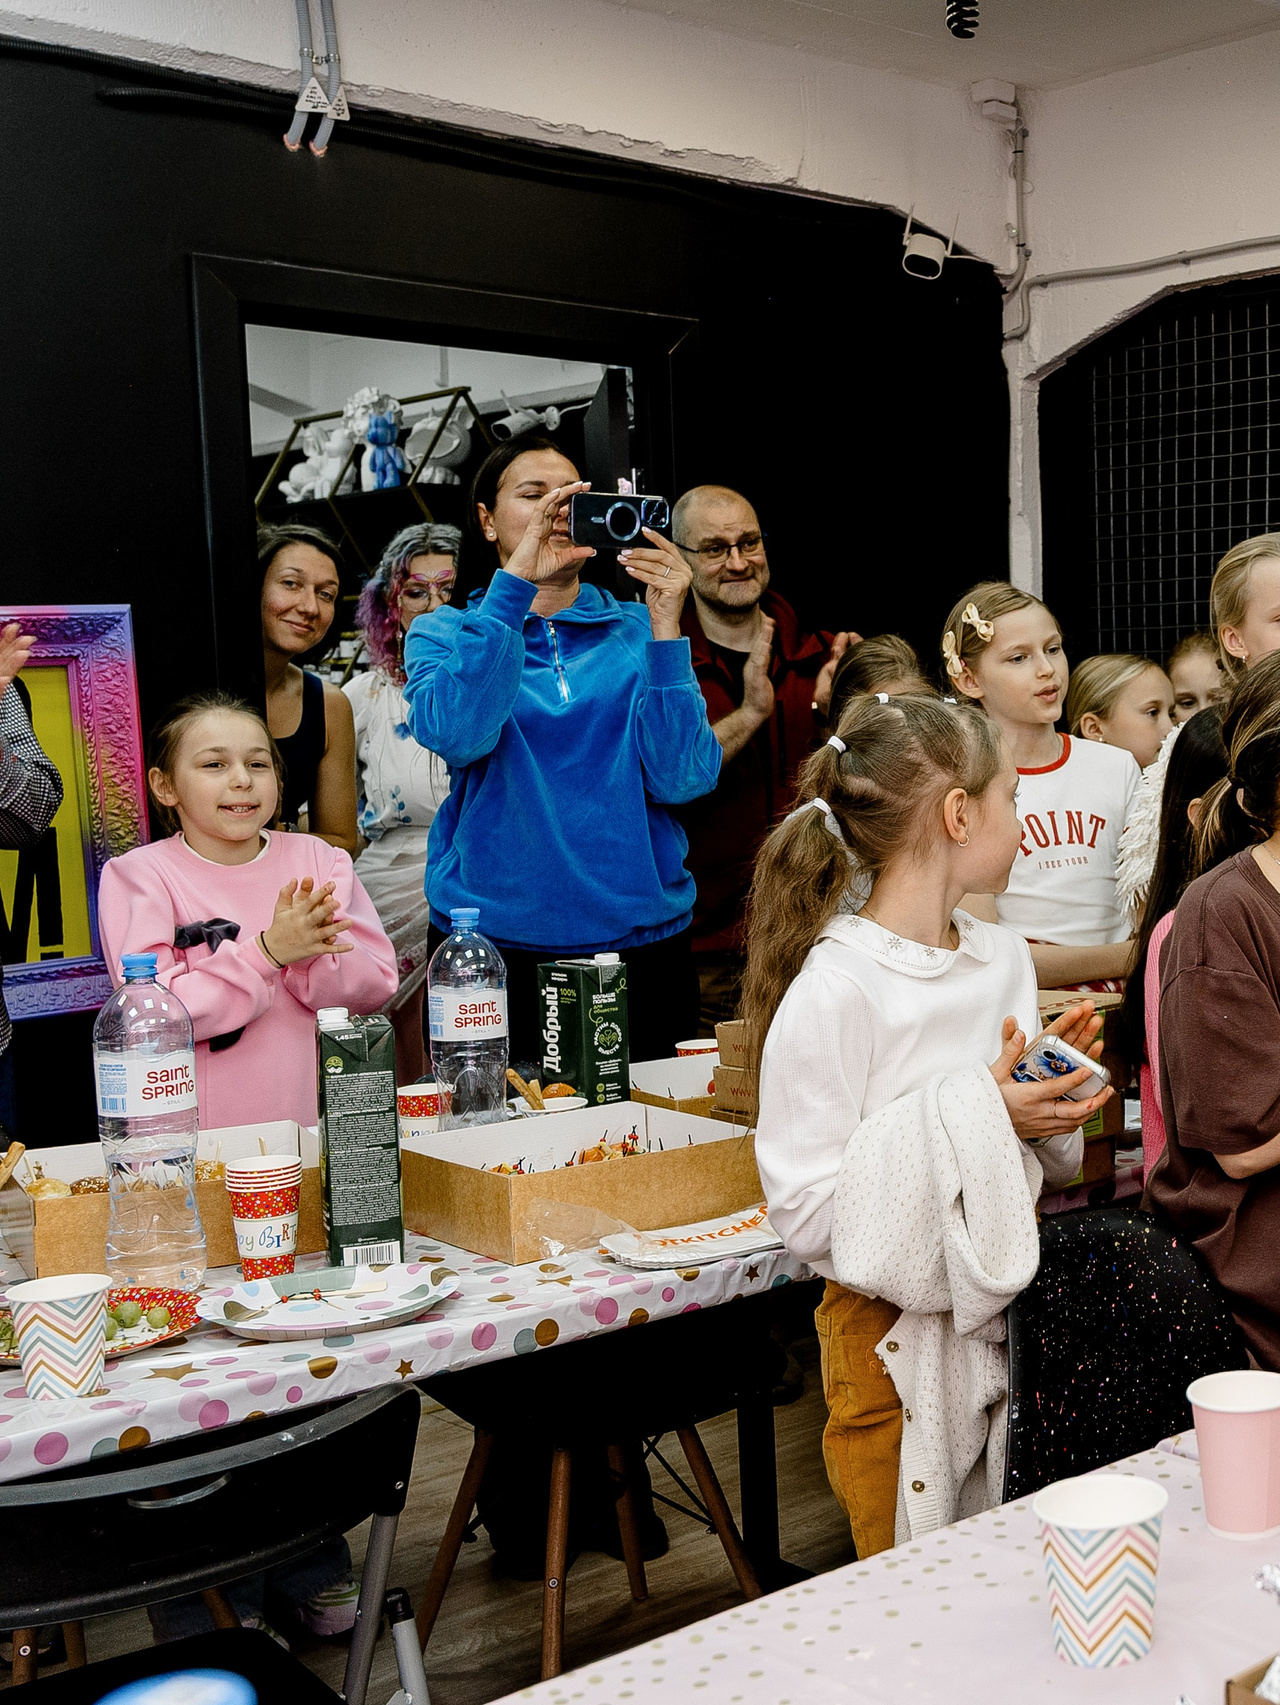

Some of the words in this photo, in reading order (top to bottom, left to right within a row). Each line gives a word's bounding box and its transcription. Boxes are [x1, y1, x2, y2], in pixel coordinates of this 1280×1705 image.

[1045, 860, 1062, 869] SEE
[1065, 856, 1089, 866] YOUR
[541, 985, 562, 1073] Добрый
